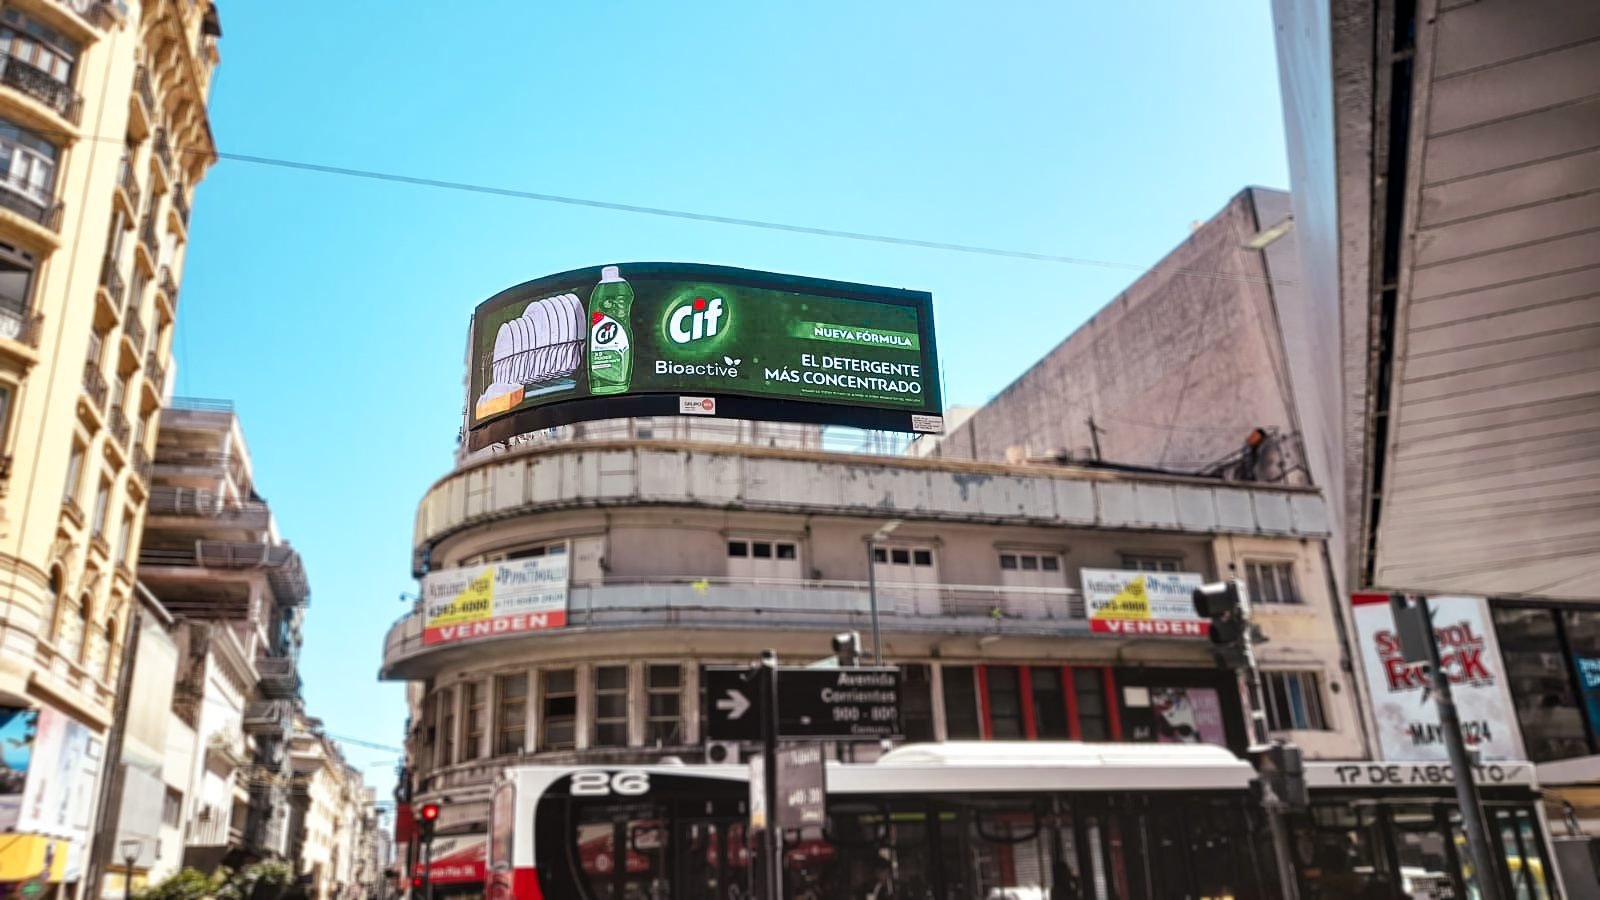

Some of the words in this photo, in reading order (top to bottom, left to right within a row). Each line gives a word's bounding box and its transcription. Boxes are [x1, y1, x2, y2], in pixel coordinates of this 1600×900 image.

[669, 297, 723, 343] Cif
[814, 327, 855, 340] NUEVA
[856, 331, 912, 346] FÓRMULA
[655, 360, 738, 377] Bioactive
[801, 354, 819, 368] EL
[822, 356, 920, 378] DETERGENTE
[764, 365, 800, 383] MÁS
[803, 371, 921, 394] CONCENTRADO
[440, 614, 548, 640] VENDEN
[1104, 620, 1201, 635] VENDEN
[837, 672, 895, 686] Avenida
[821, 688, 897, 703] Corrientes
[832, 706, 860, 721] 900
[570, 771, 650, 796] 26
[1366, 766, 1403, 783] DE
